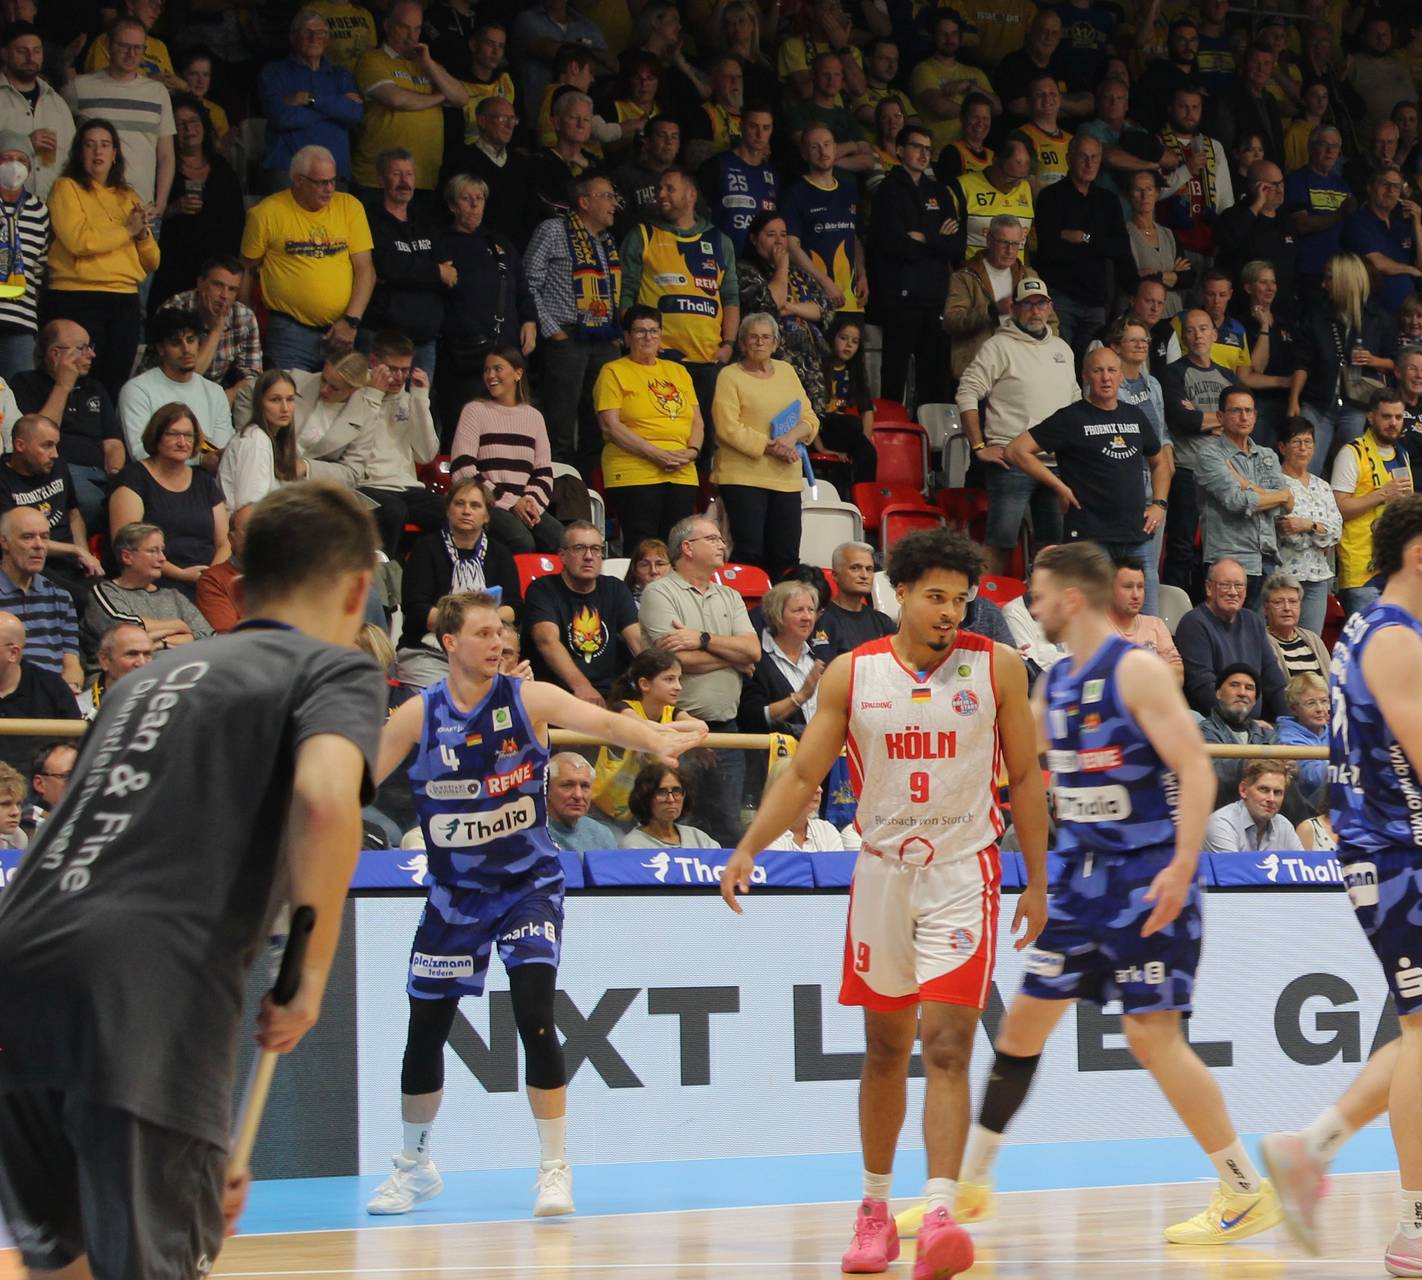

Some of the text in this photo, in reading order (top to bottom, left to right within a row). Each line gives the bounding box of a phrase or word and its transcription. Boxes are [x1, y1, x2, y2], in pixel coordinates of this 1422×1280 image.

[1041, 151, 1059, 165] 90
[727, 172, 749, 193] 25
[635, 186, 658, 205] THE
[976, 191, 997, 206] 67
[676, 299, 716, 316] Thalia
[1083, 423, 1141, 437] PHOENIX HAGEN
[1101, 446, 1138, 460] BASKETBALL
[860, 700, 893, 710] SPALDING
[884, 725, 957, 760] KÖLN
[440, 744, 461, 773] 4
[59, 660, 210, 893] Clean & Fine
[487, 763, 532, 795] REWE
[909, 771, 929, 803] 9
[1390, 743, 1409, 777] wilo
[1400, 778, 1422, 812] wilo
[464, 808, 527, 841] Thalia
[919, 816, 939, 826] von
[1282, 858, 1343, 884] Thali
[502, 921, 541, 943] mark
[413, 954, 472, 970] platzmann
[855, 942, 870, 973] 9
